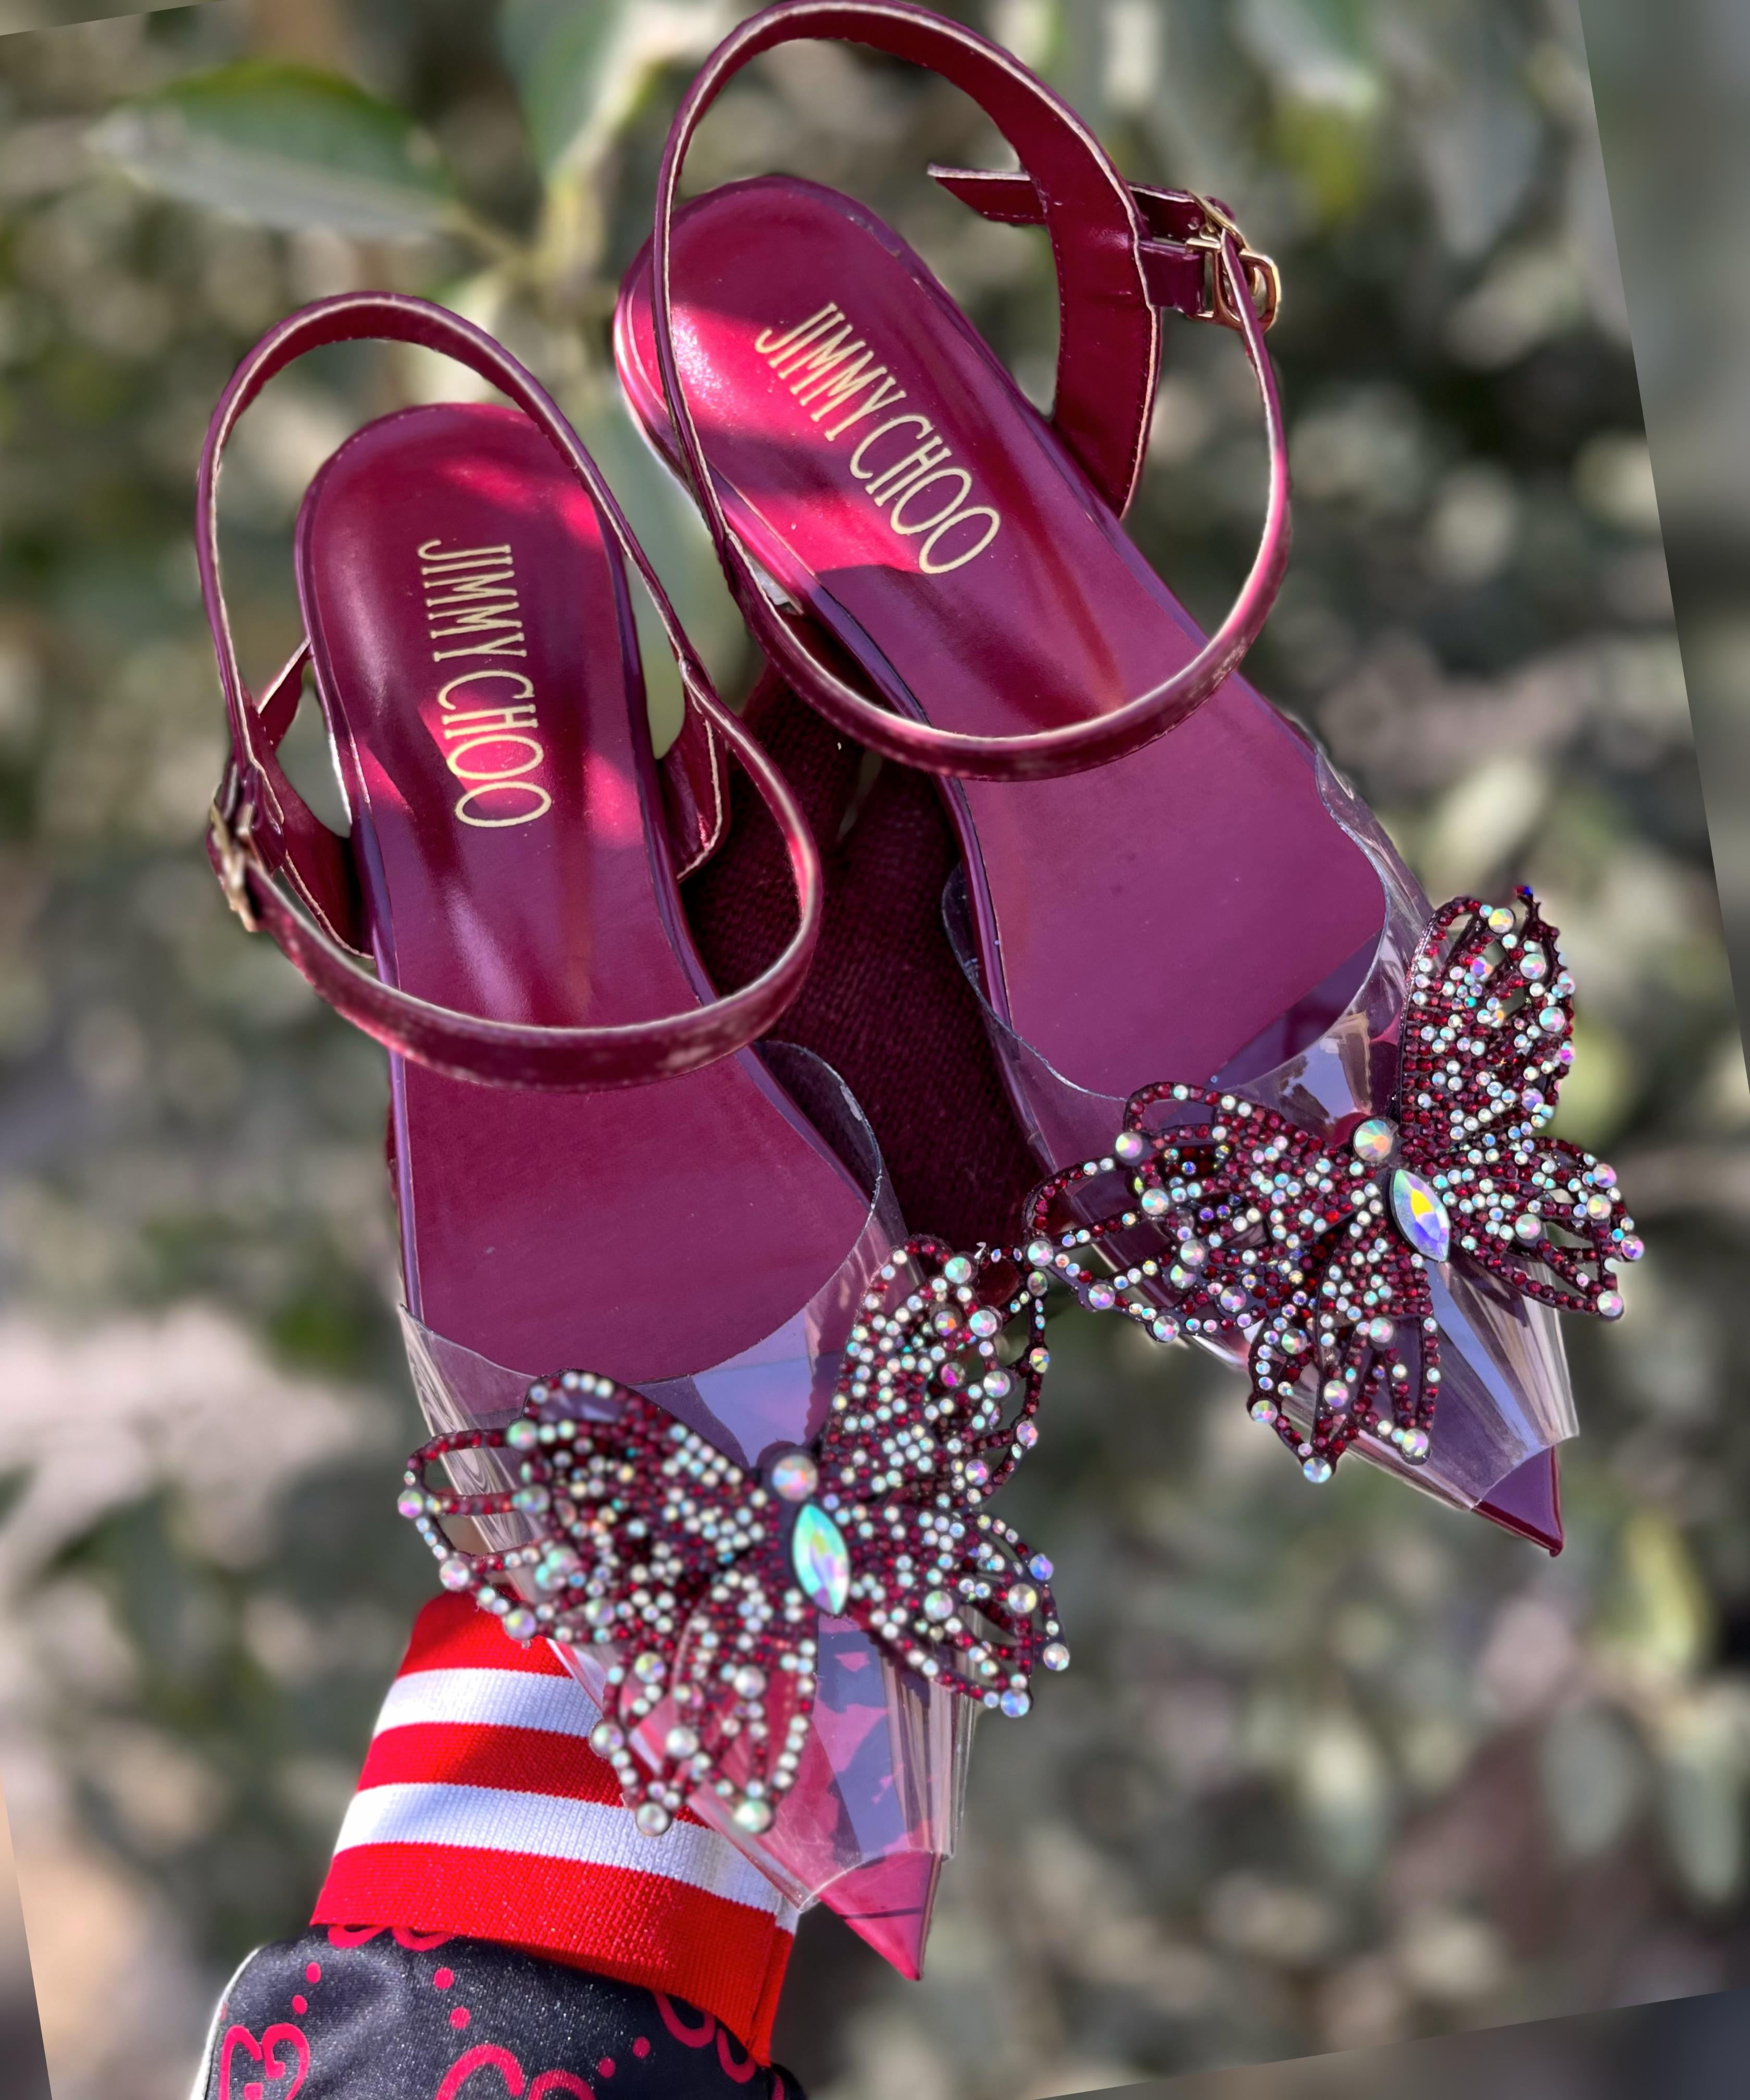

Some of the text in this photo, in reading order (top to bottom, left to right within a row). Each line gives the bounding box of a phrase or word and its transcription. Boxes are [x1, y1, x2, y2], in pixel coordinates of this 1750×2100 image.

[755, 302, 999, 573] JIMMY CHOO
[418, 539, 552, 828] JIMMY CHOO
